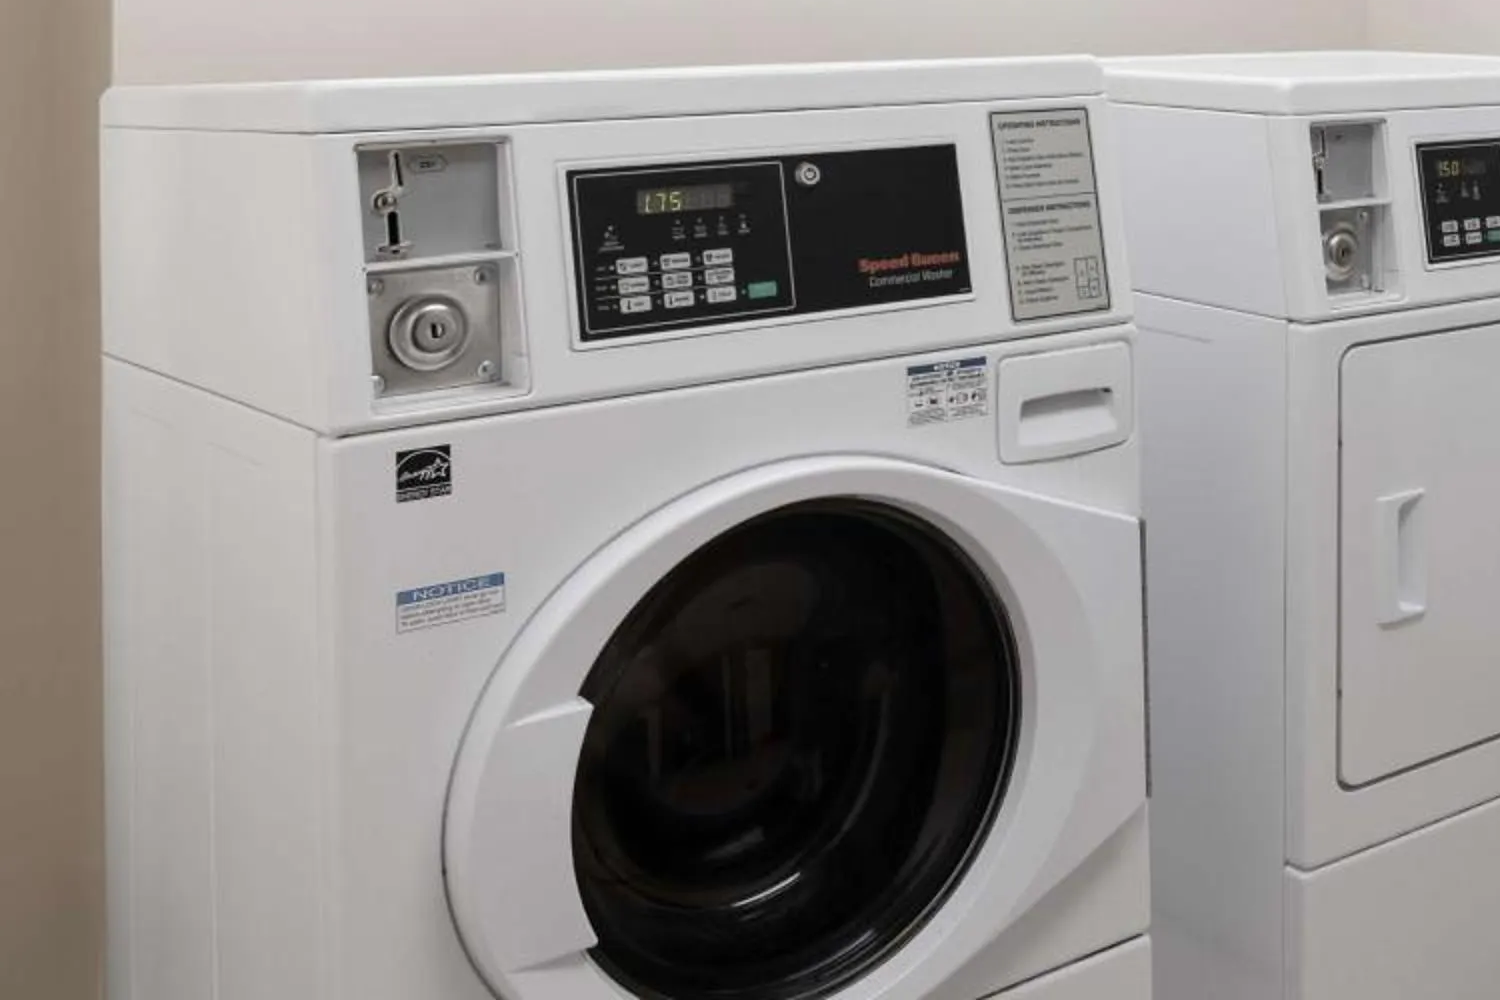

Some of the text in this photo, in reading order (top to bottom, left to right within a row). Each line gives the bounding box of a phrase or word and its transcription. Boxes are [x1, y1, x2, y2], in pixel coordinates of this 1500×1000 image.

[858, 251, 960, 274] Speed Queen
[413, 578, 491, 601] NOTICE
